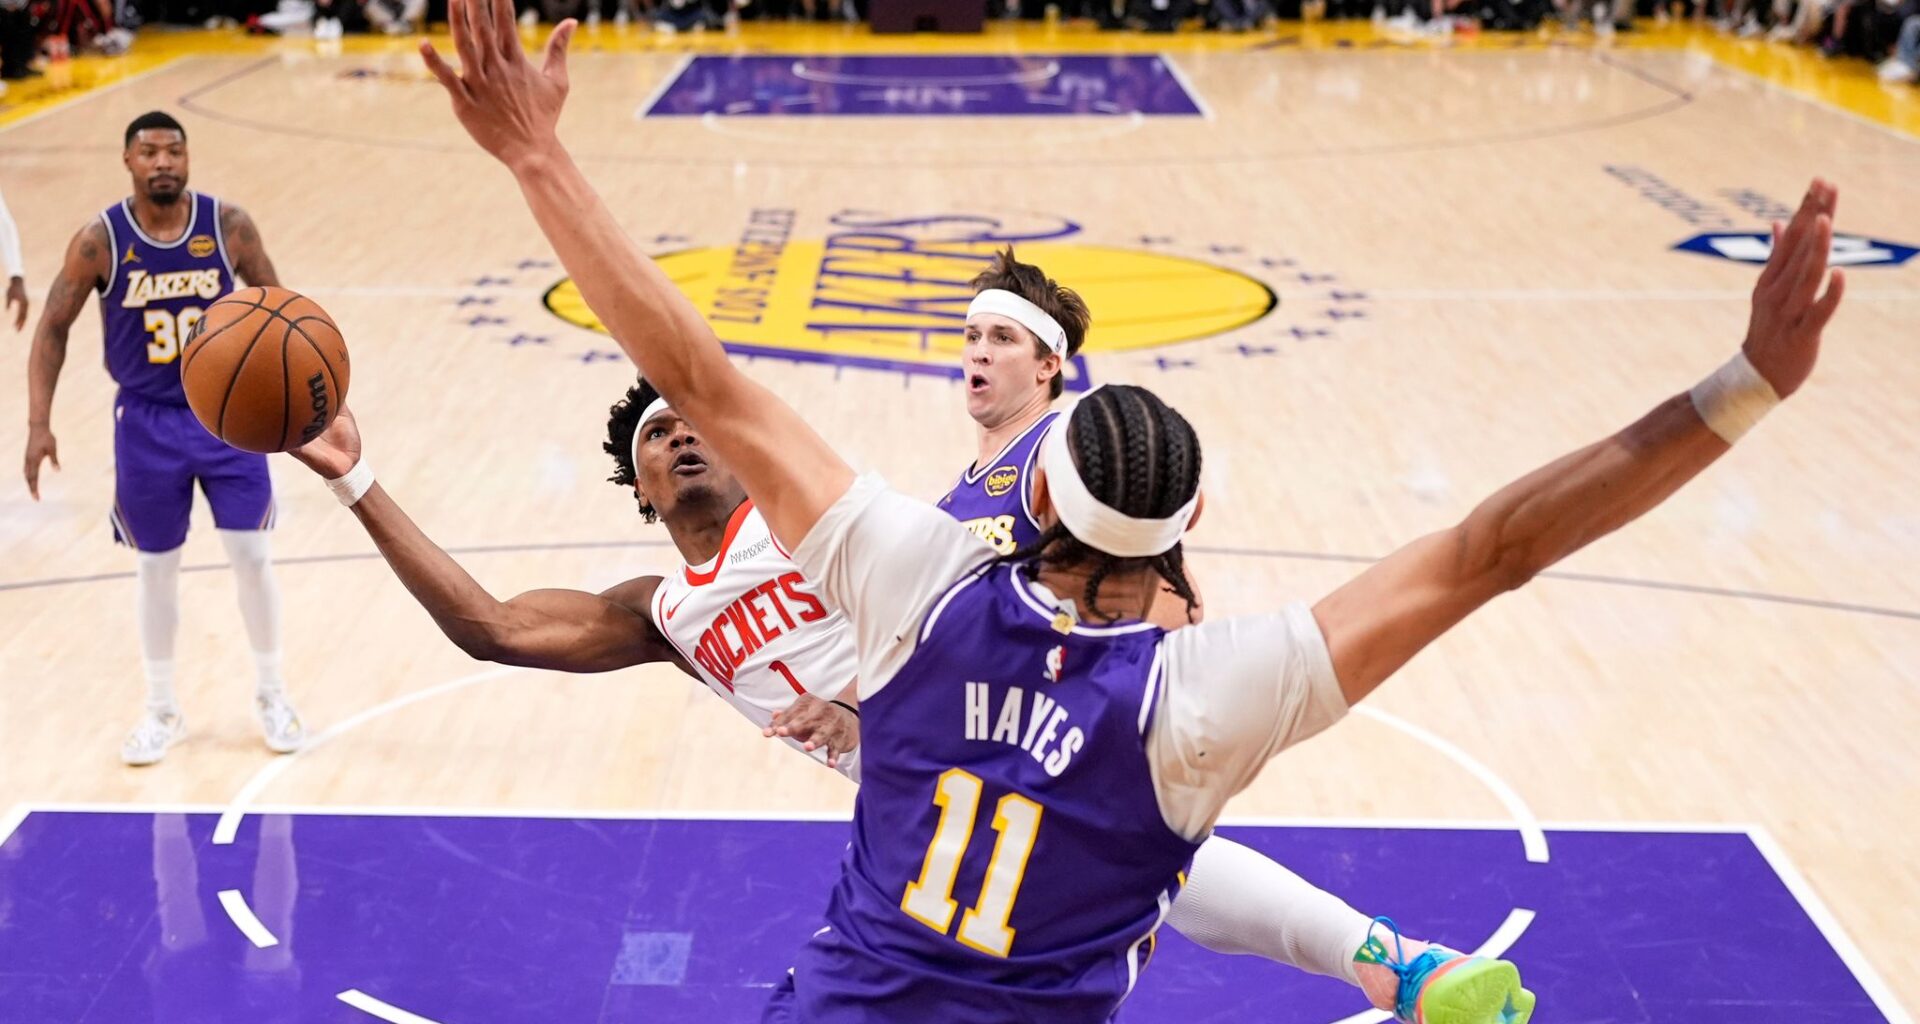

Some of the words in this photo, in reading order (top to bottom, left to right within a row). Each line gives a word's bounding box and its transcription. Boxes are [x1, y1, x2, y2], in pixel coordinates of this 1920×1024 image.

[727, 208, 796, 285] ANGELES
[122, 268, 222, 308] LAKERS
[708, 287, 768, 323] LOS
[694, 571, 827, 695] ROCKETS
[768, 660, 807, 695] 1
[965, 681, 1085, 777] HAYES
[900, 767, 1044, 959] 11
